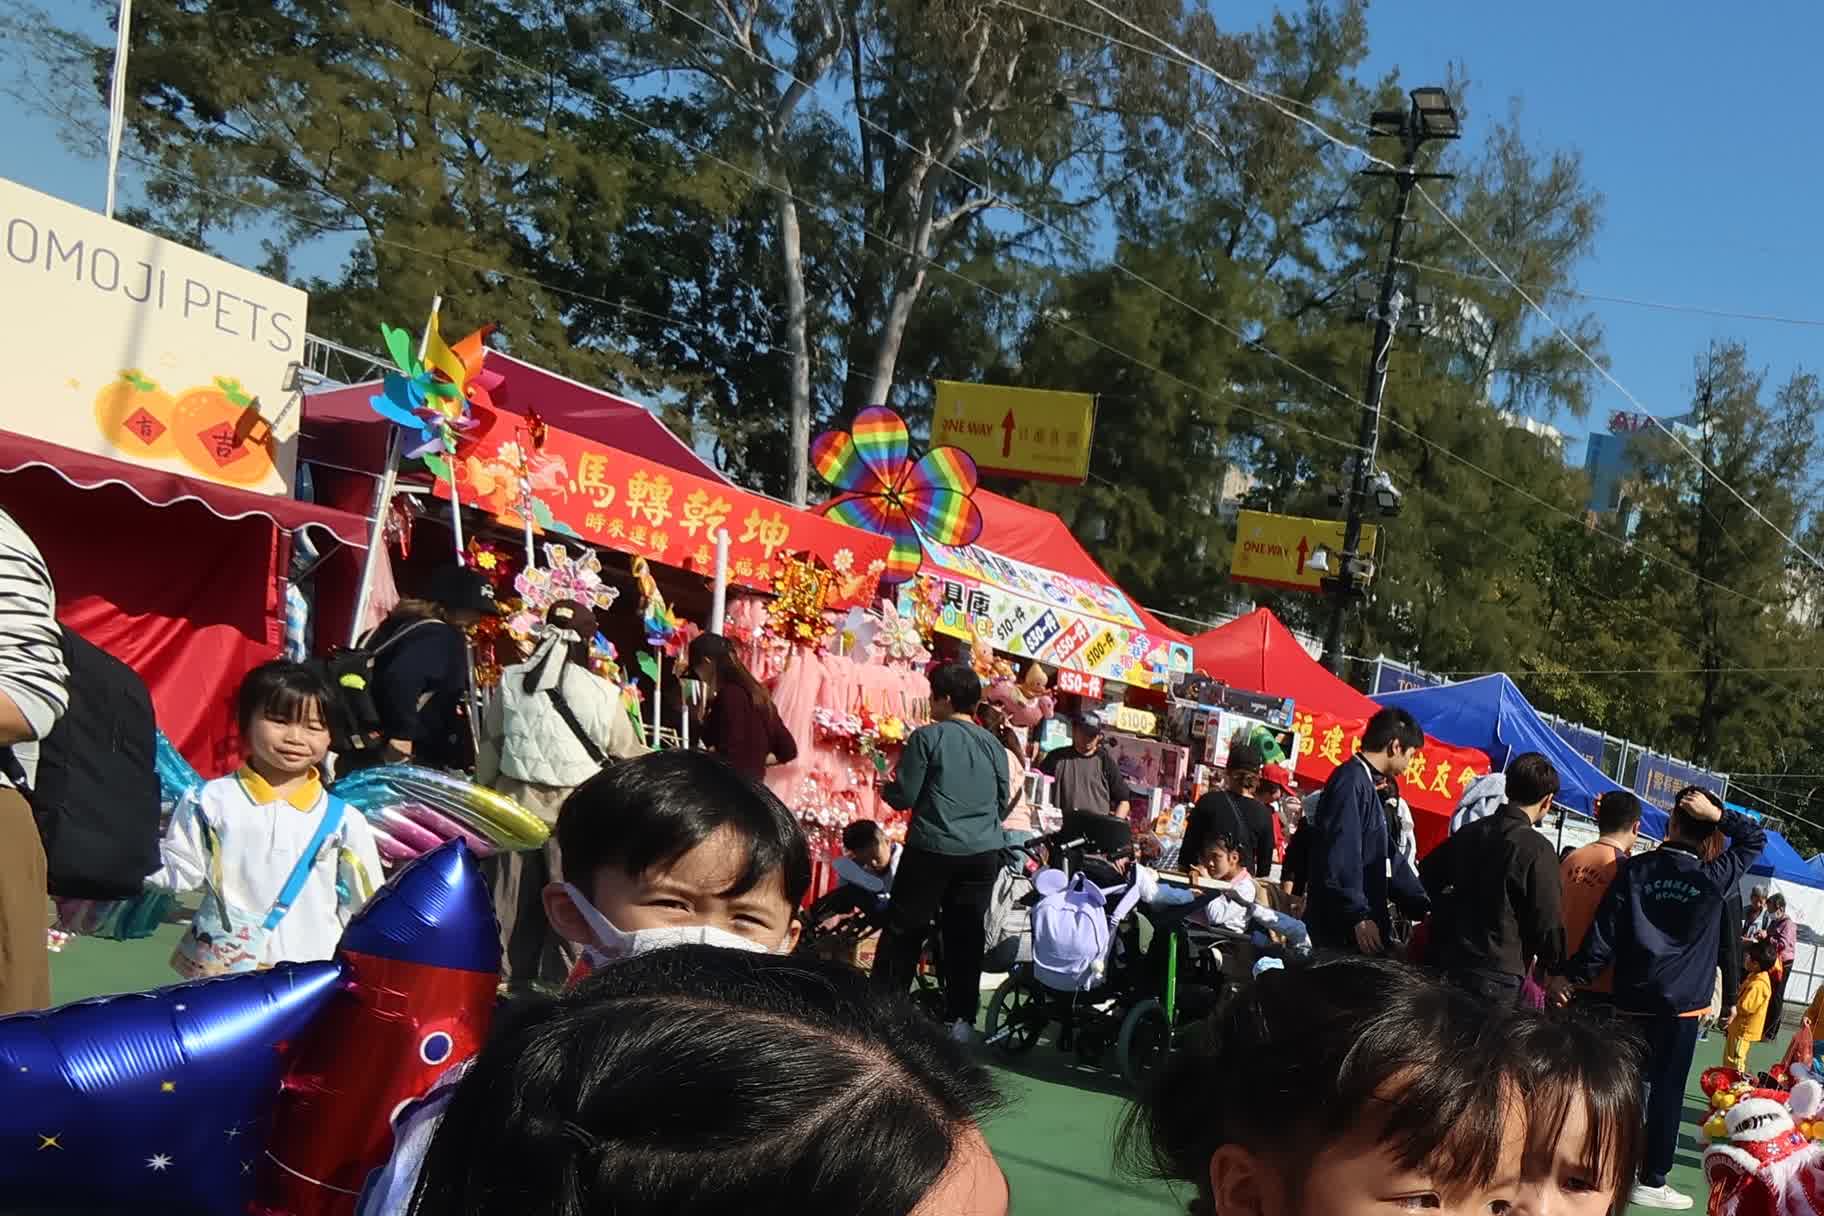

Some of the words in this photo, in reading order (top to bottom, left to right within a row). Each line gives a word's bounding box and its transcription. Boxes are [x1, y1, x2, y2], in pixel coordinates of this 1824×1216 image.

[183, 278, 293, 352] PETS
[967, 422, 993, 437] WAY
[568, 451, 790, 559] 馬轉乾坤
